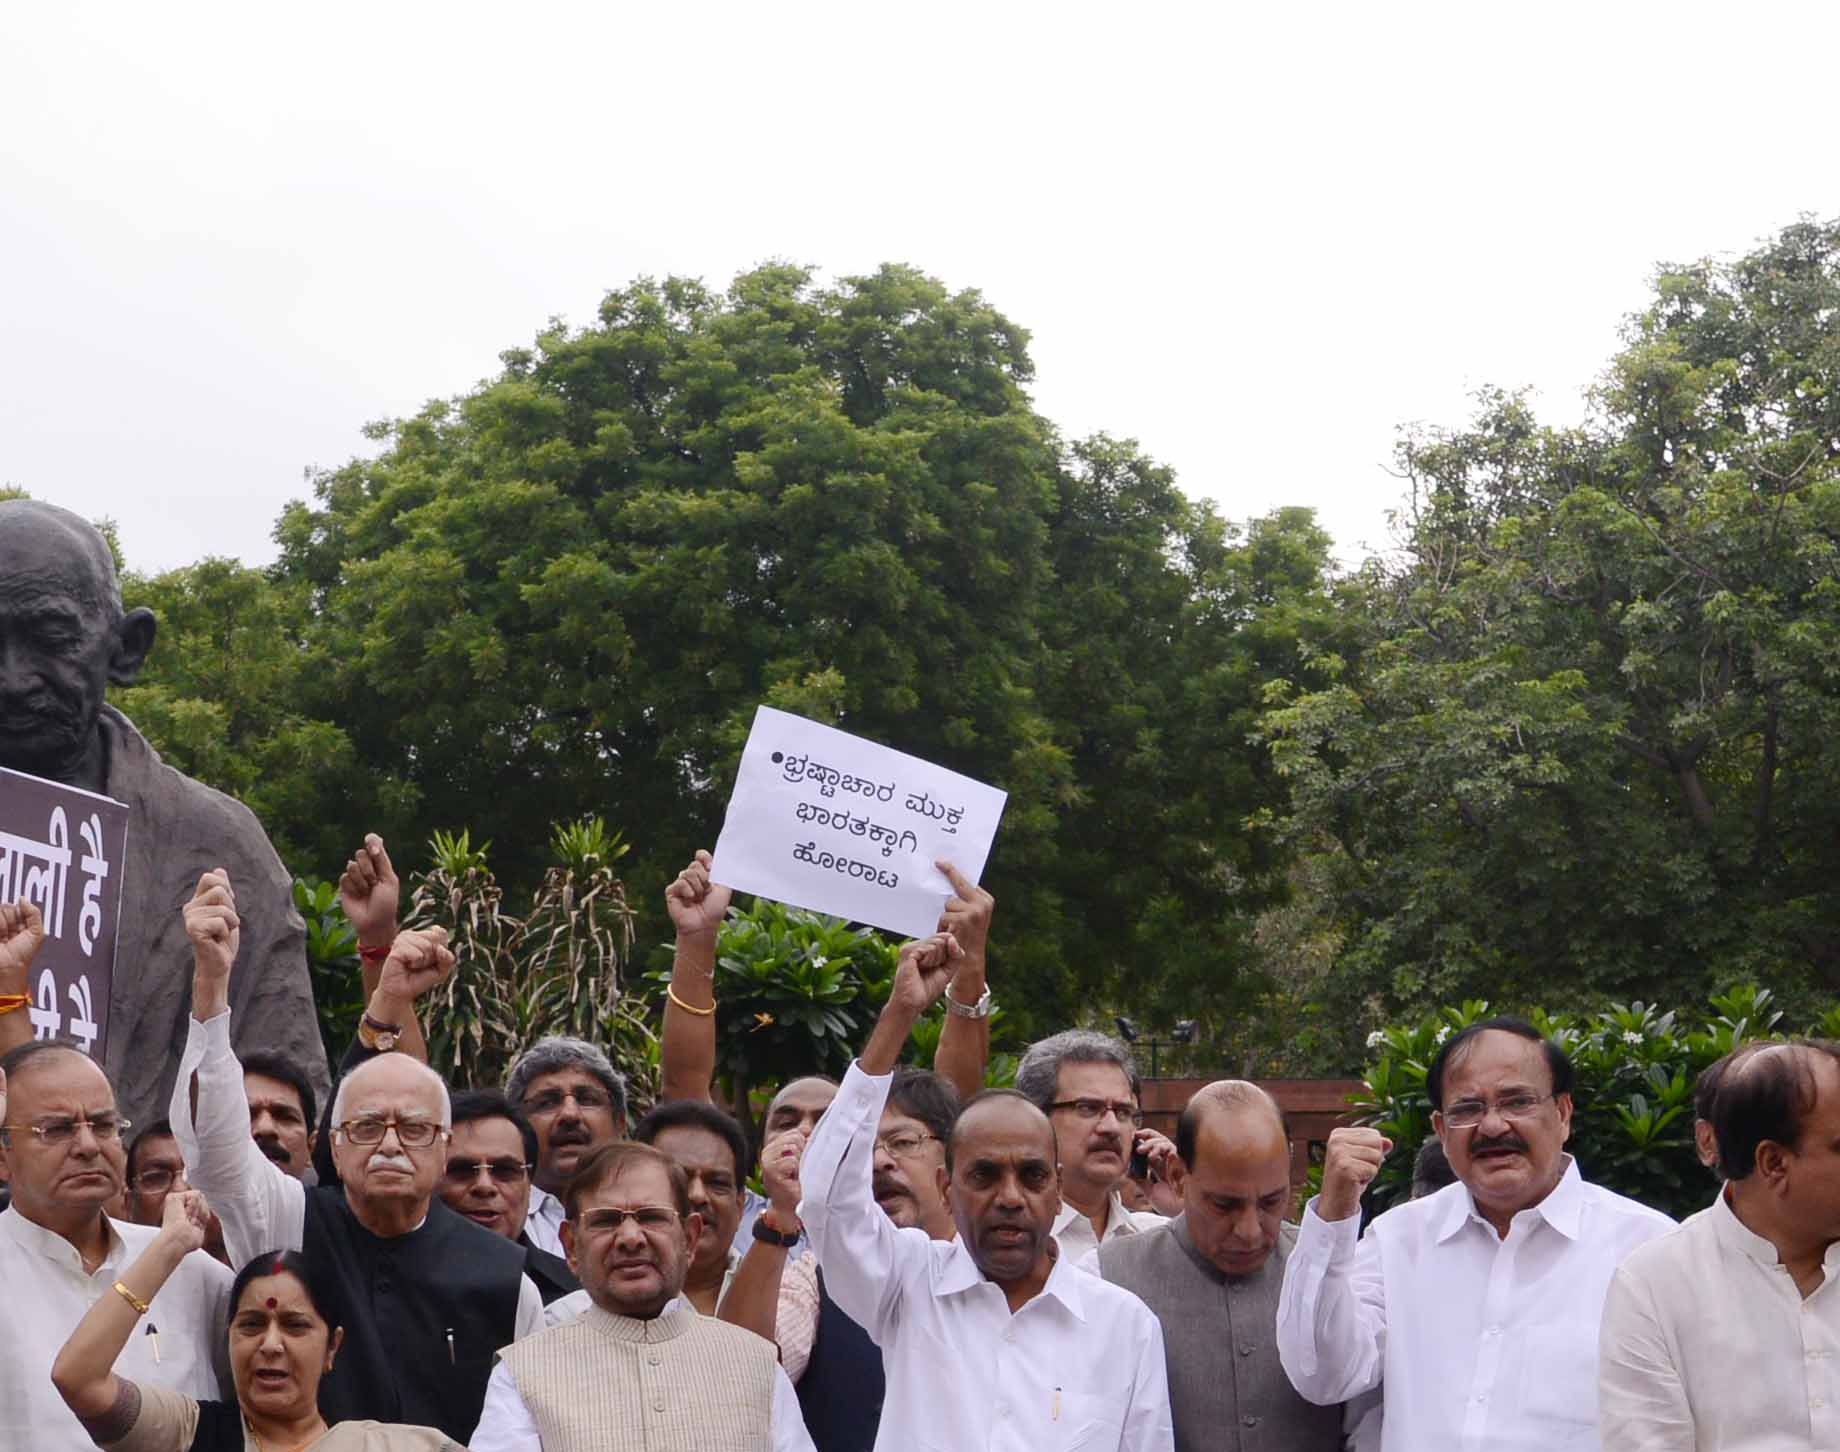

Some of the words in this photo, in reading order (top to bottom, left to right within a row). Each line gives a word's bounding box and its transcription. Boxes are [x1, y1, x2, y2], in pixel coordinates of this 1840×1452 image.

[905, 792, 965, 834] ಮುಕ್ತ
[76, 813, 109, 957] है
[792, 841, 899, 889] ಹೋರಾಟ
